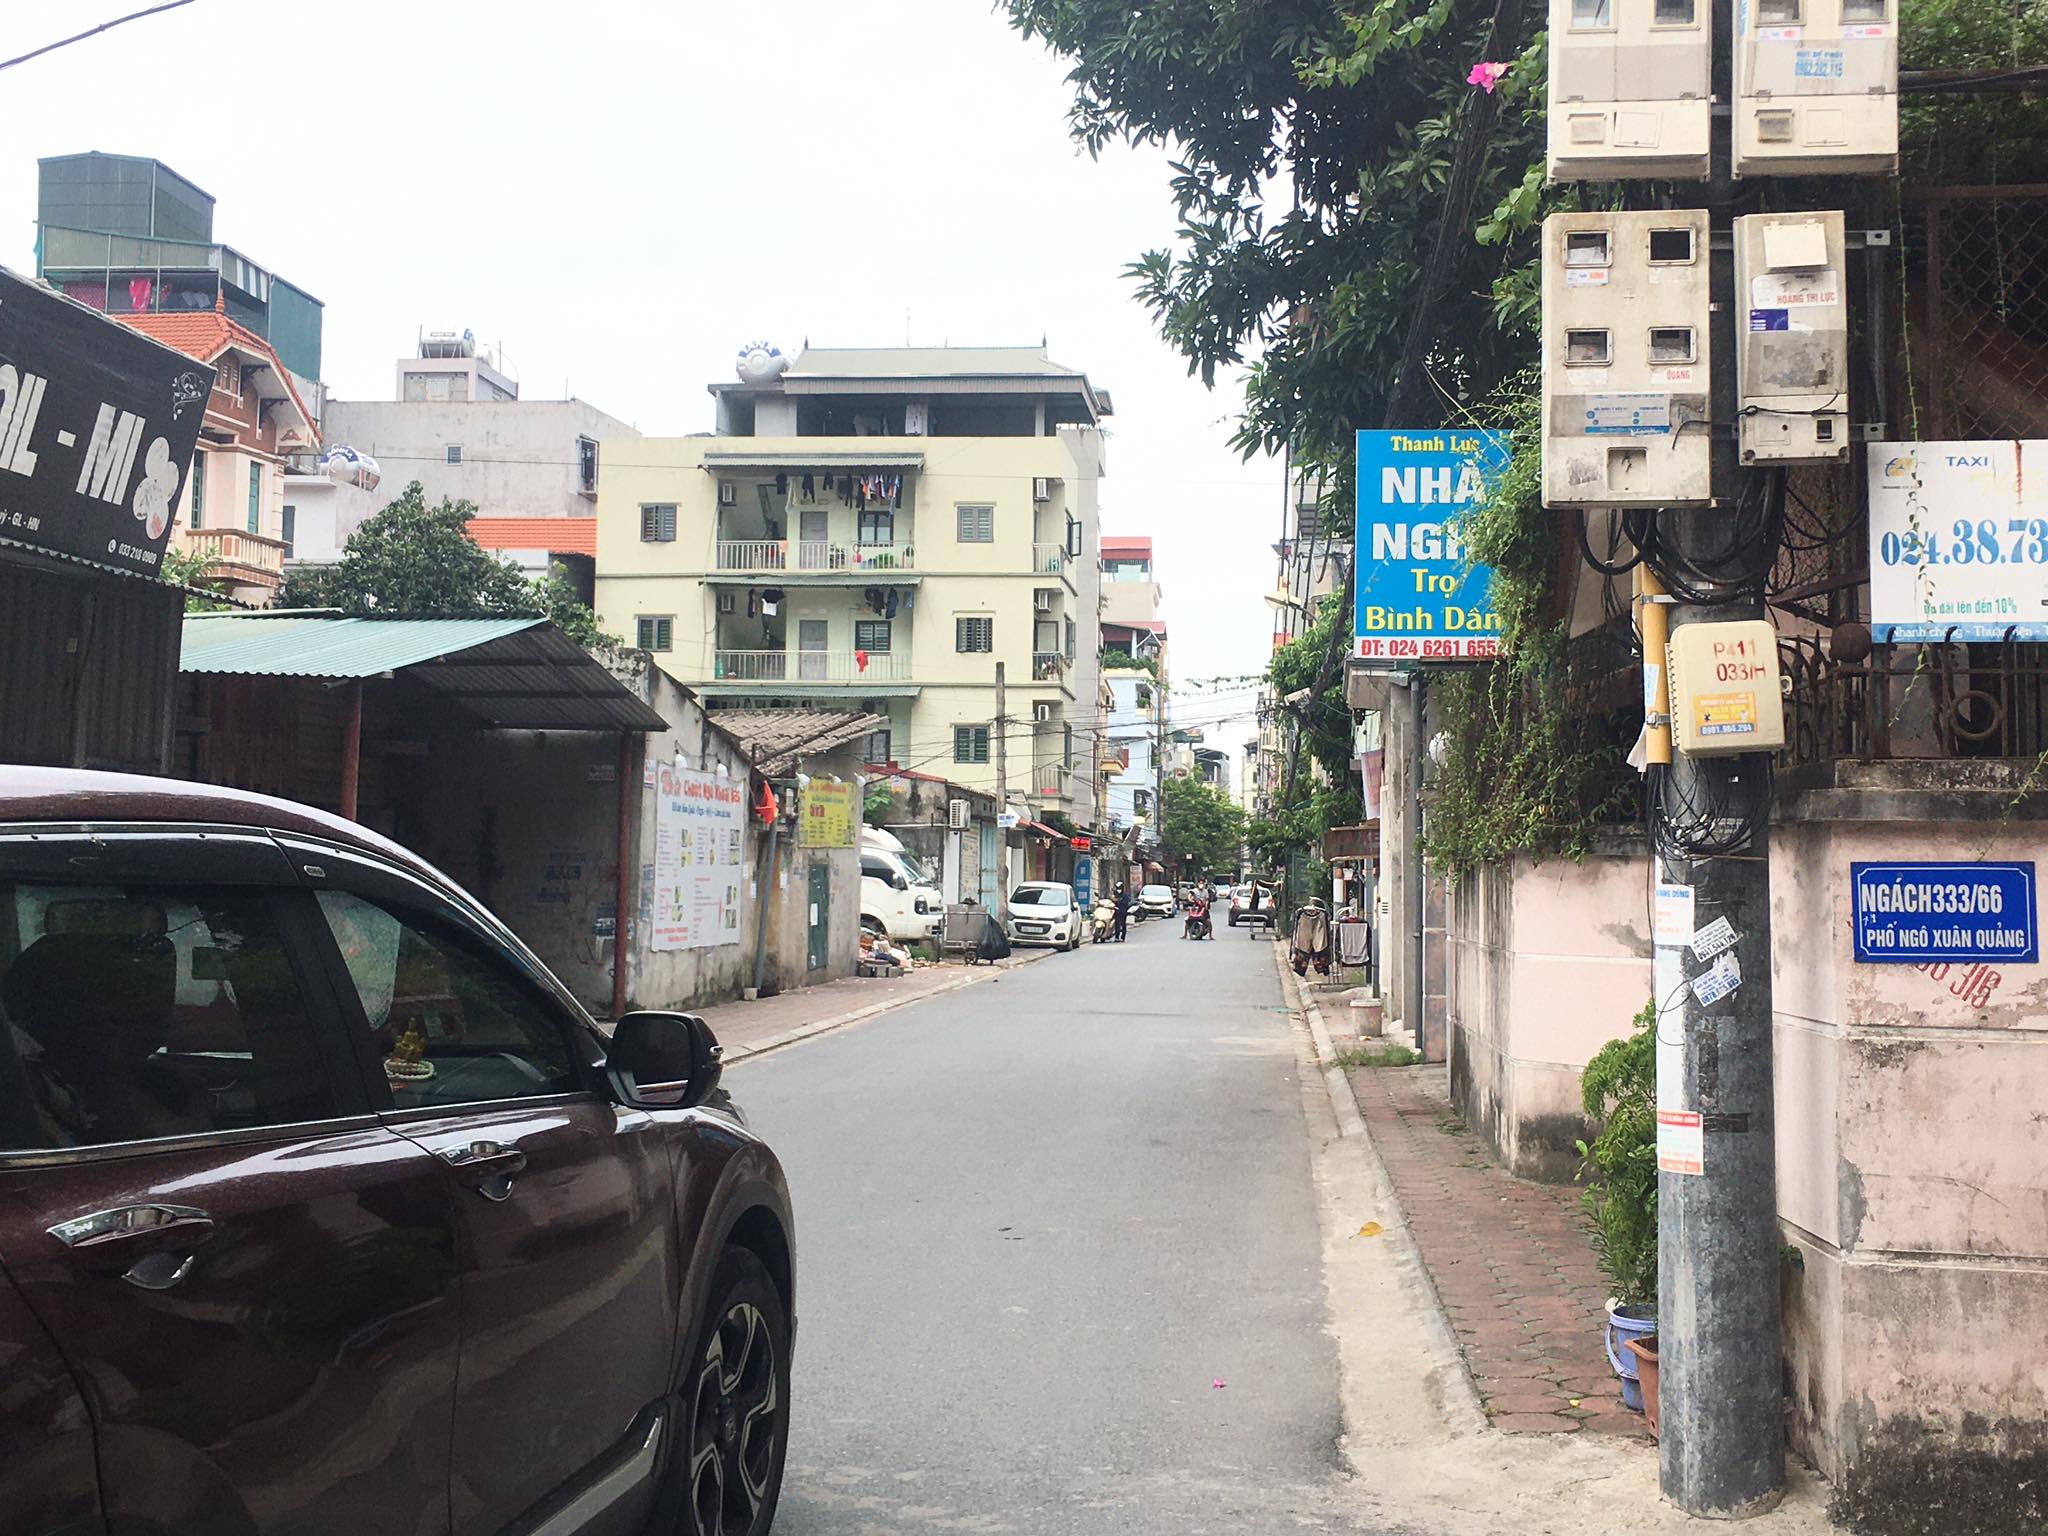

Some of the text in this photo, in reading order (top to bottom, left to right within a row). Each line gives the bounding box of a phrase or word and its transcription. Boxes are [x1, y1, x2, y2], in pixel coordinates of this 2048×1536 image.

[1391, 435, 1444, 452] Thanh
[1945, 456, 1989, 467] TAXI
[1410, 568, 1456, 599] Trọ
[1997, 597, 2017, 614] 10%
[1366, 606, 1502, 630] Bình Dân
[1361, 640, 1384, 656] ĐT:
[1389, 640, 1418, 656] 024
[1423, 639, 1460, 656] 6261
[1866, 921, 2025, 950] PHỐ NGÔ XUÂN QUẢNG
